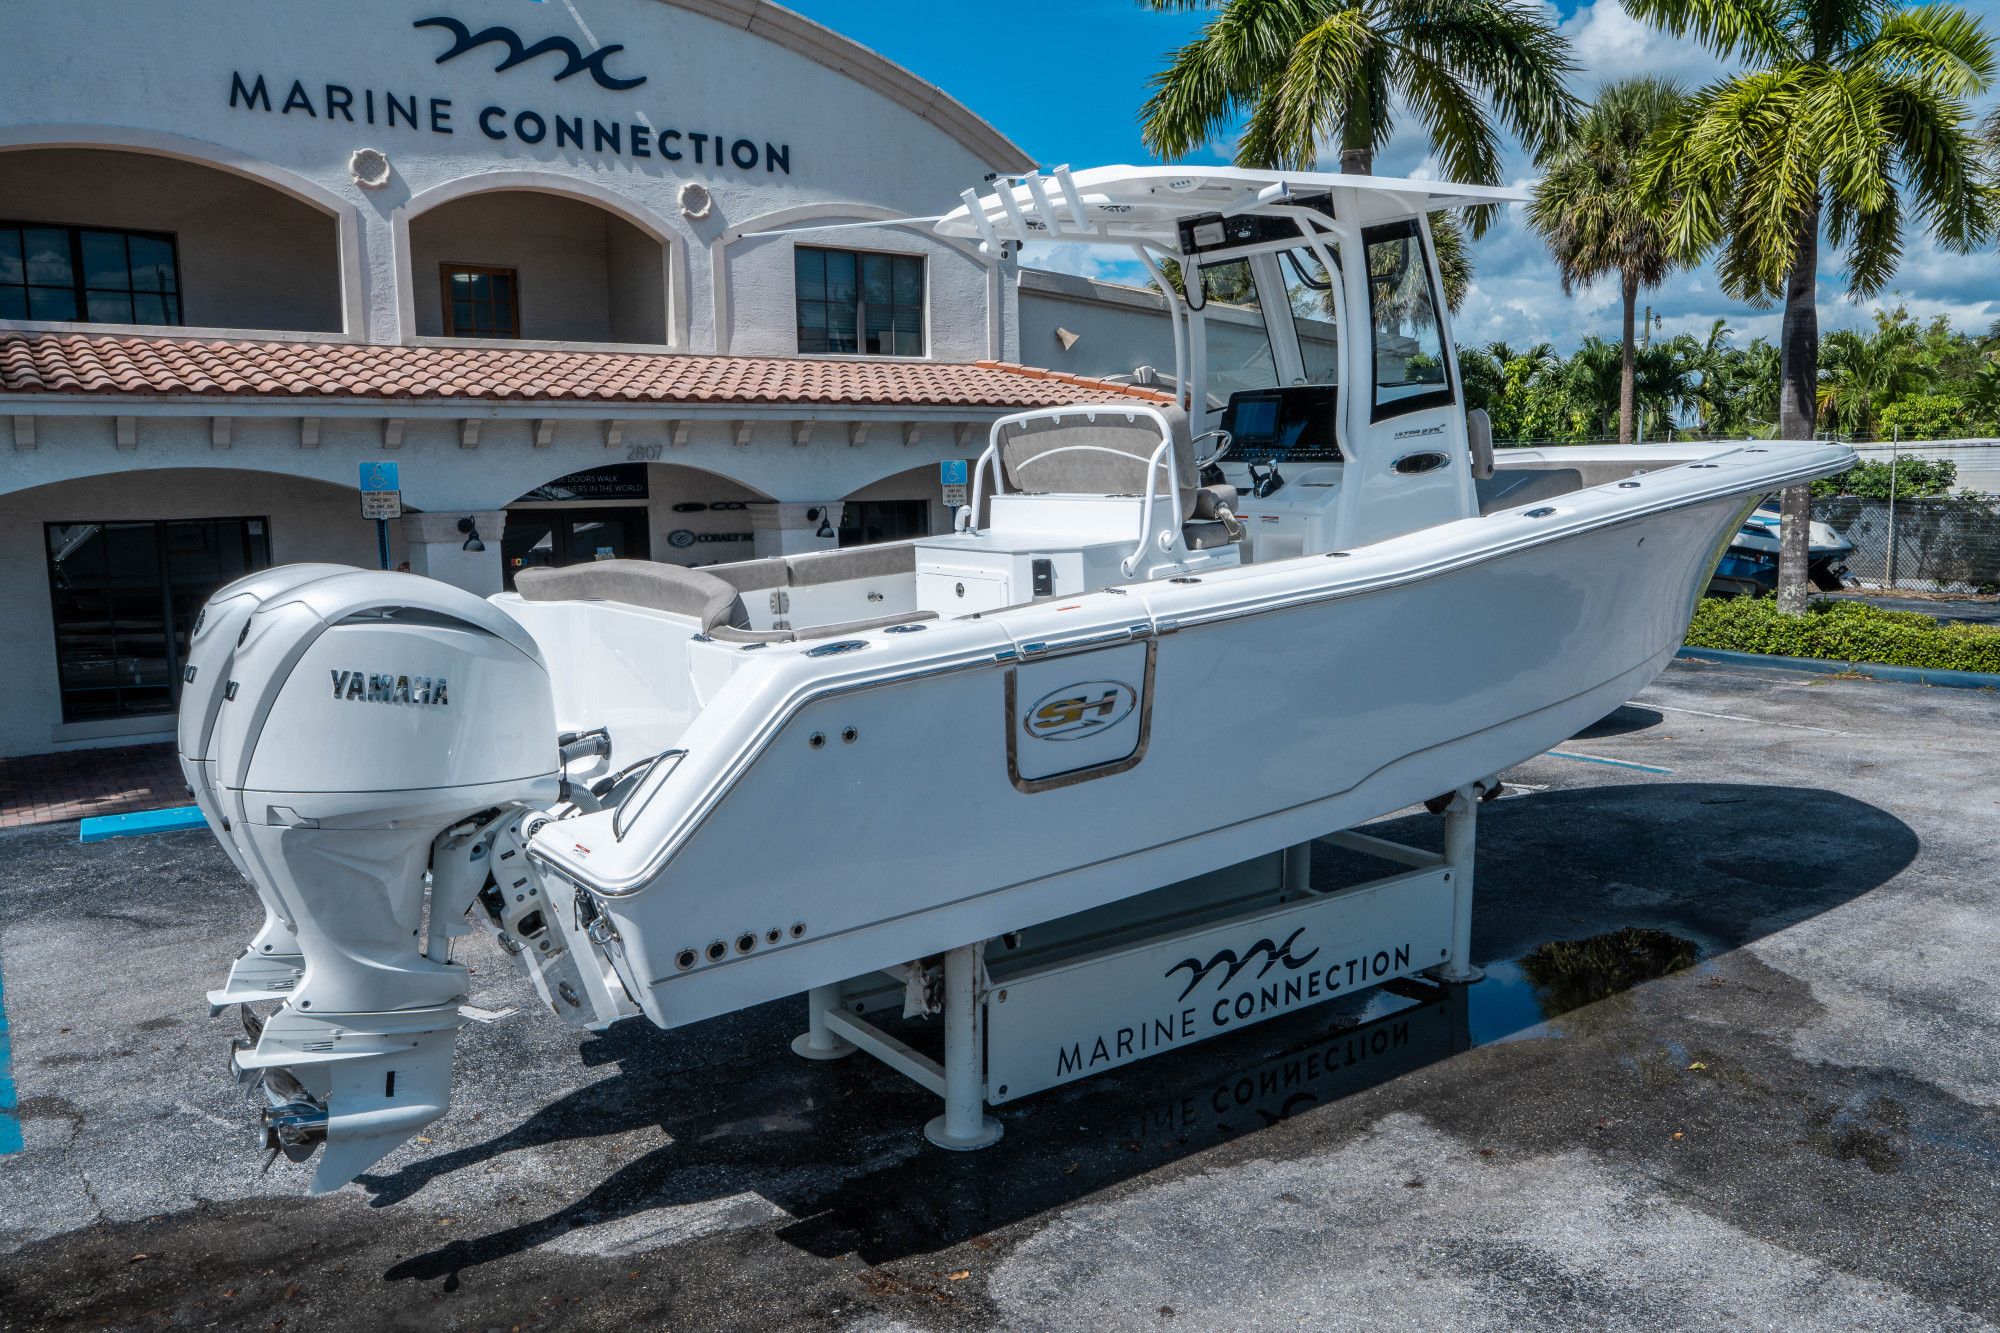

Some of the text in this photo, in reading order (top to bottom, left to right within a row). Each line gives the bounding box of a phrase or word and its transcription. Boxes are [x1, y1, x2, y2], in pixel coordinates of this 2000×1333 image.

[230, 70, 791, 175] MARINE CONNECTION
[626, 444, 662, 460] 2807
[567, 475, 596, 484] DOORS
[597, 474, 618, 483] WALK
[589, 485, 598, 493] IN
[599, 484, 614, 493] THE
[698, 532, 740, 543] COBALT
[330, 669, 448, 705] YAMAHA
[1057, 943, 1410, 1077] MARINE CONNECTION
